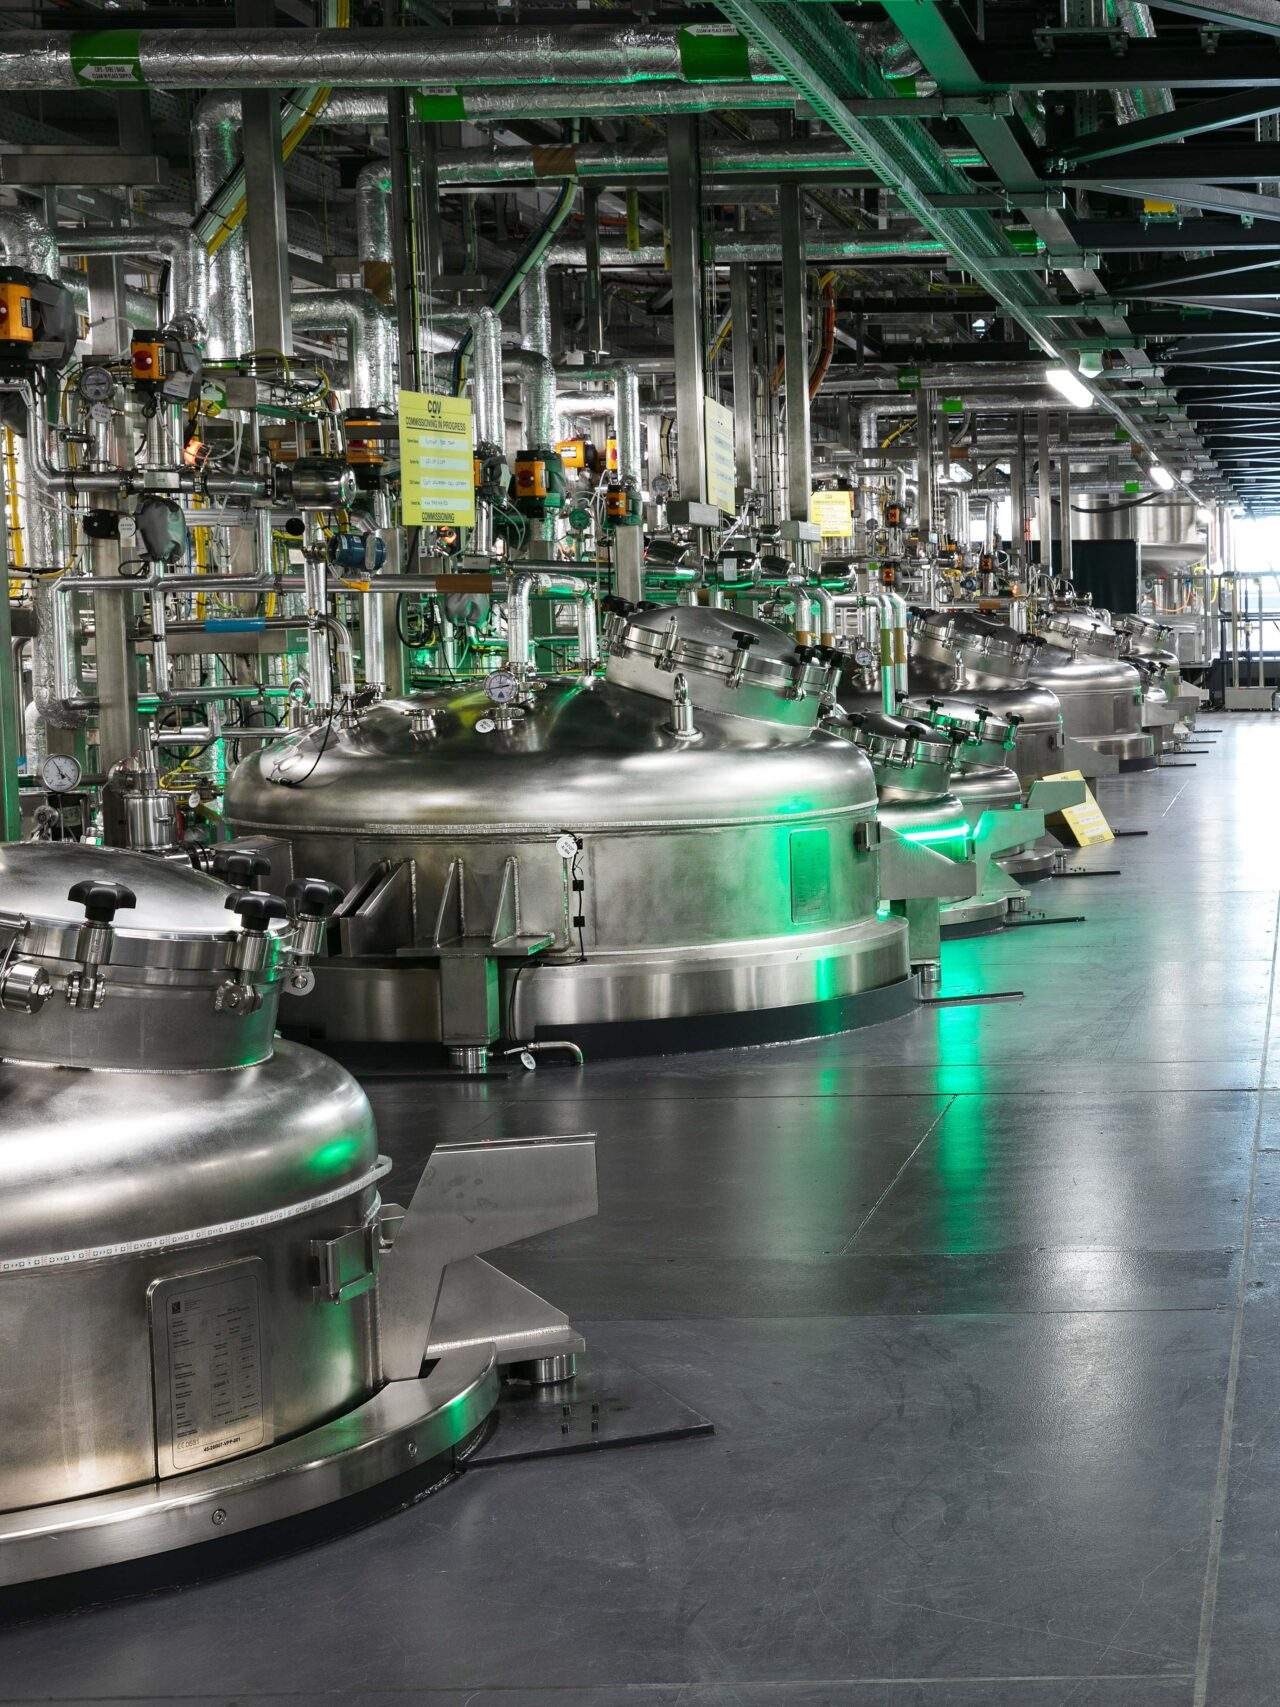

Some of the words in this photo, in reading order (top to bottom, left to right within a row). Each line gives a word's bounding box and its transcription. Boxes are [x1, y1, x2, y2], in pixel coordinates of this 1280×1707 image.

[428, 400, 442, 414] CQV
[406, 416, 438, 430] COMMISSIONING
[442, 420, 466, 432] PROGRESS
[422, 512, 454, 522] COMMISSIONING
